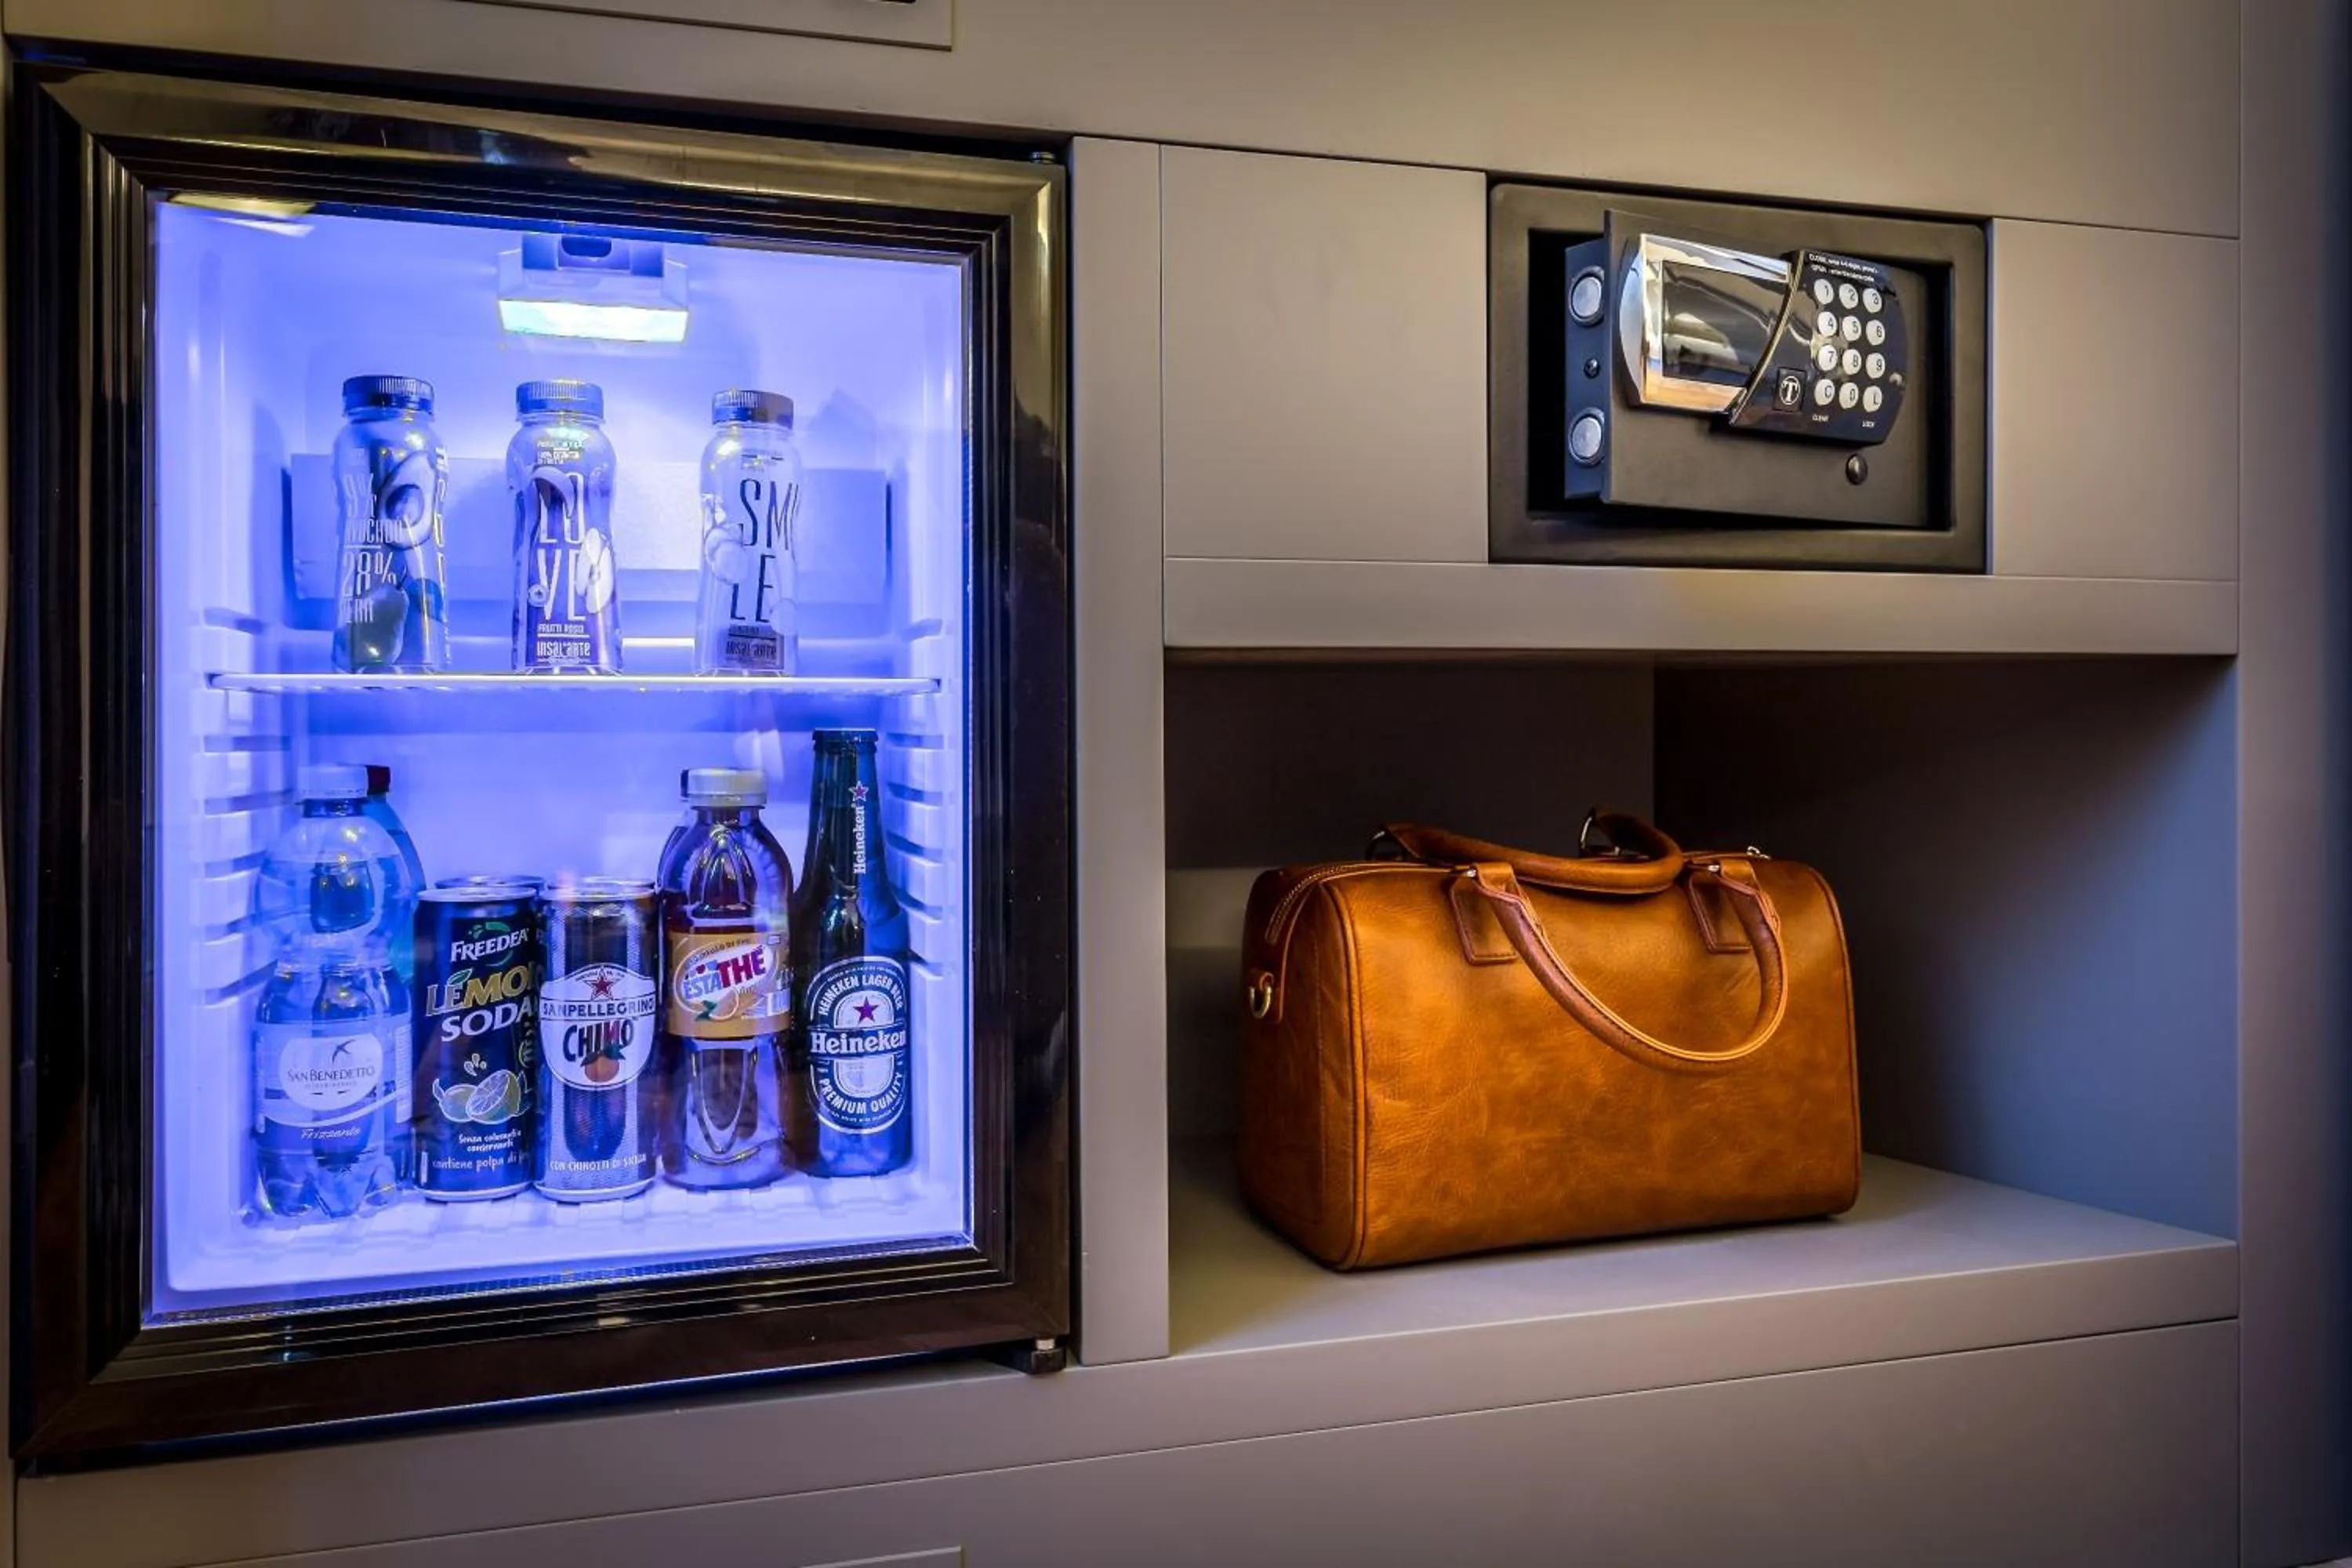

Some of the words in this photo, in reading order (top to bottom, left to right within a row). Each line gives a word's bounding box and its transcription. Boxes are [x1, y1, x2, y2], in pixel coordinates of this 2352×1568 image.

[853, 805, 866, 874] Heineken
[543, 998, 654, 1017] SANPELLEGRINO
[818, 975, 861, 1016] HEINEKEN
[862, 974, 893, 990] LAGER
[441, 996, 533, 1042] SODA
[810, 1029, 906, 1054] Heineken
[819, 1078, 866, 1114] PREMIUM
[870, 1072, 902, 1112] QUALITY
[476, 1155, 504, 1173] polpa
